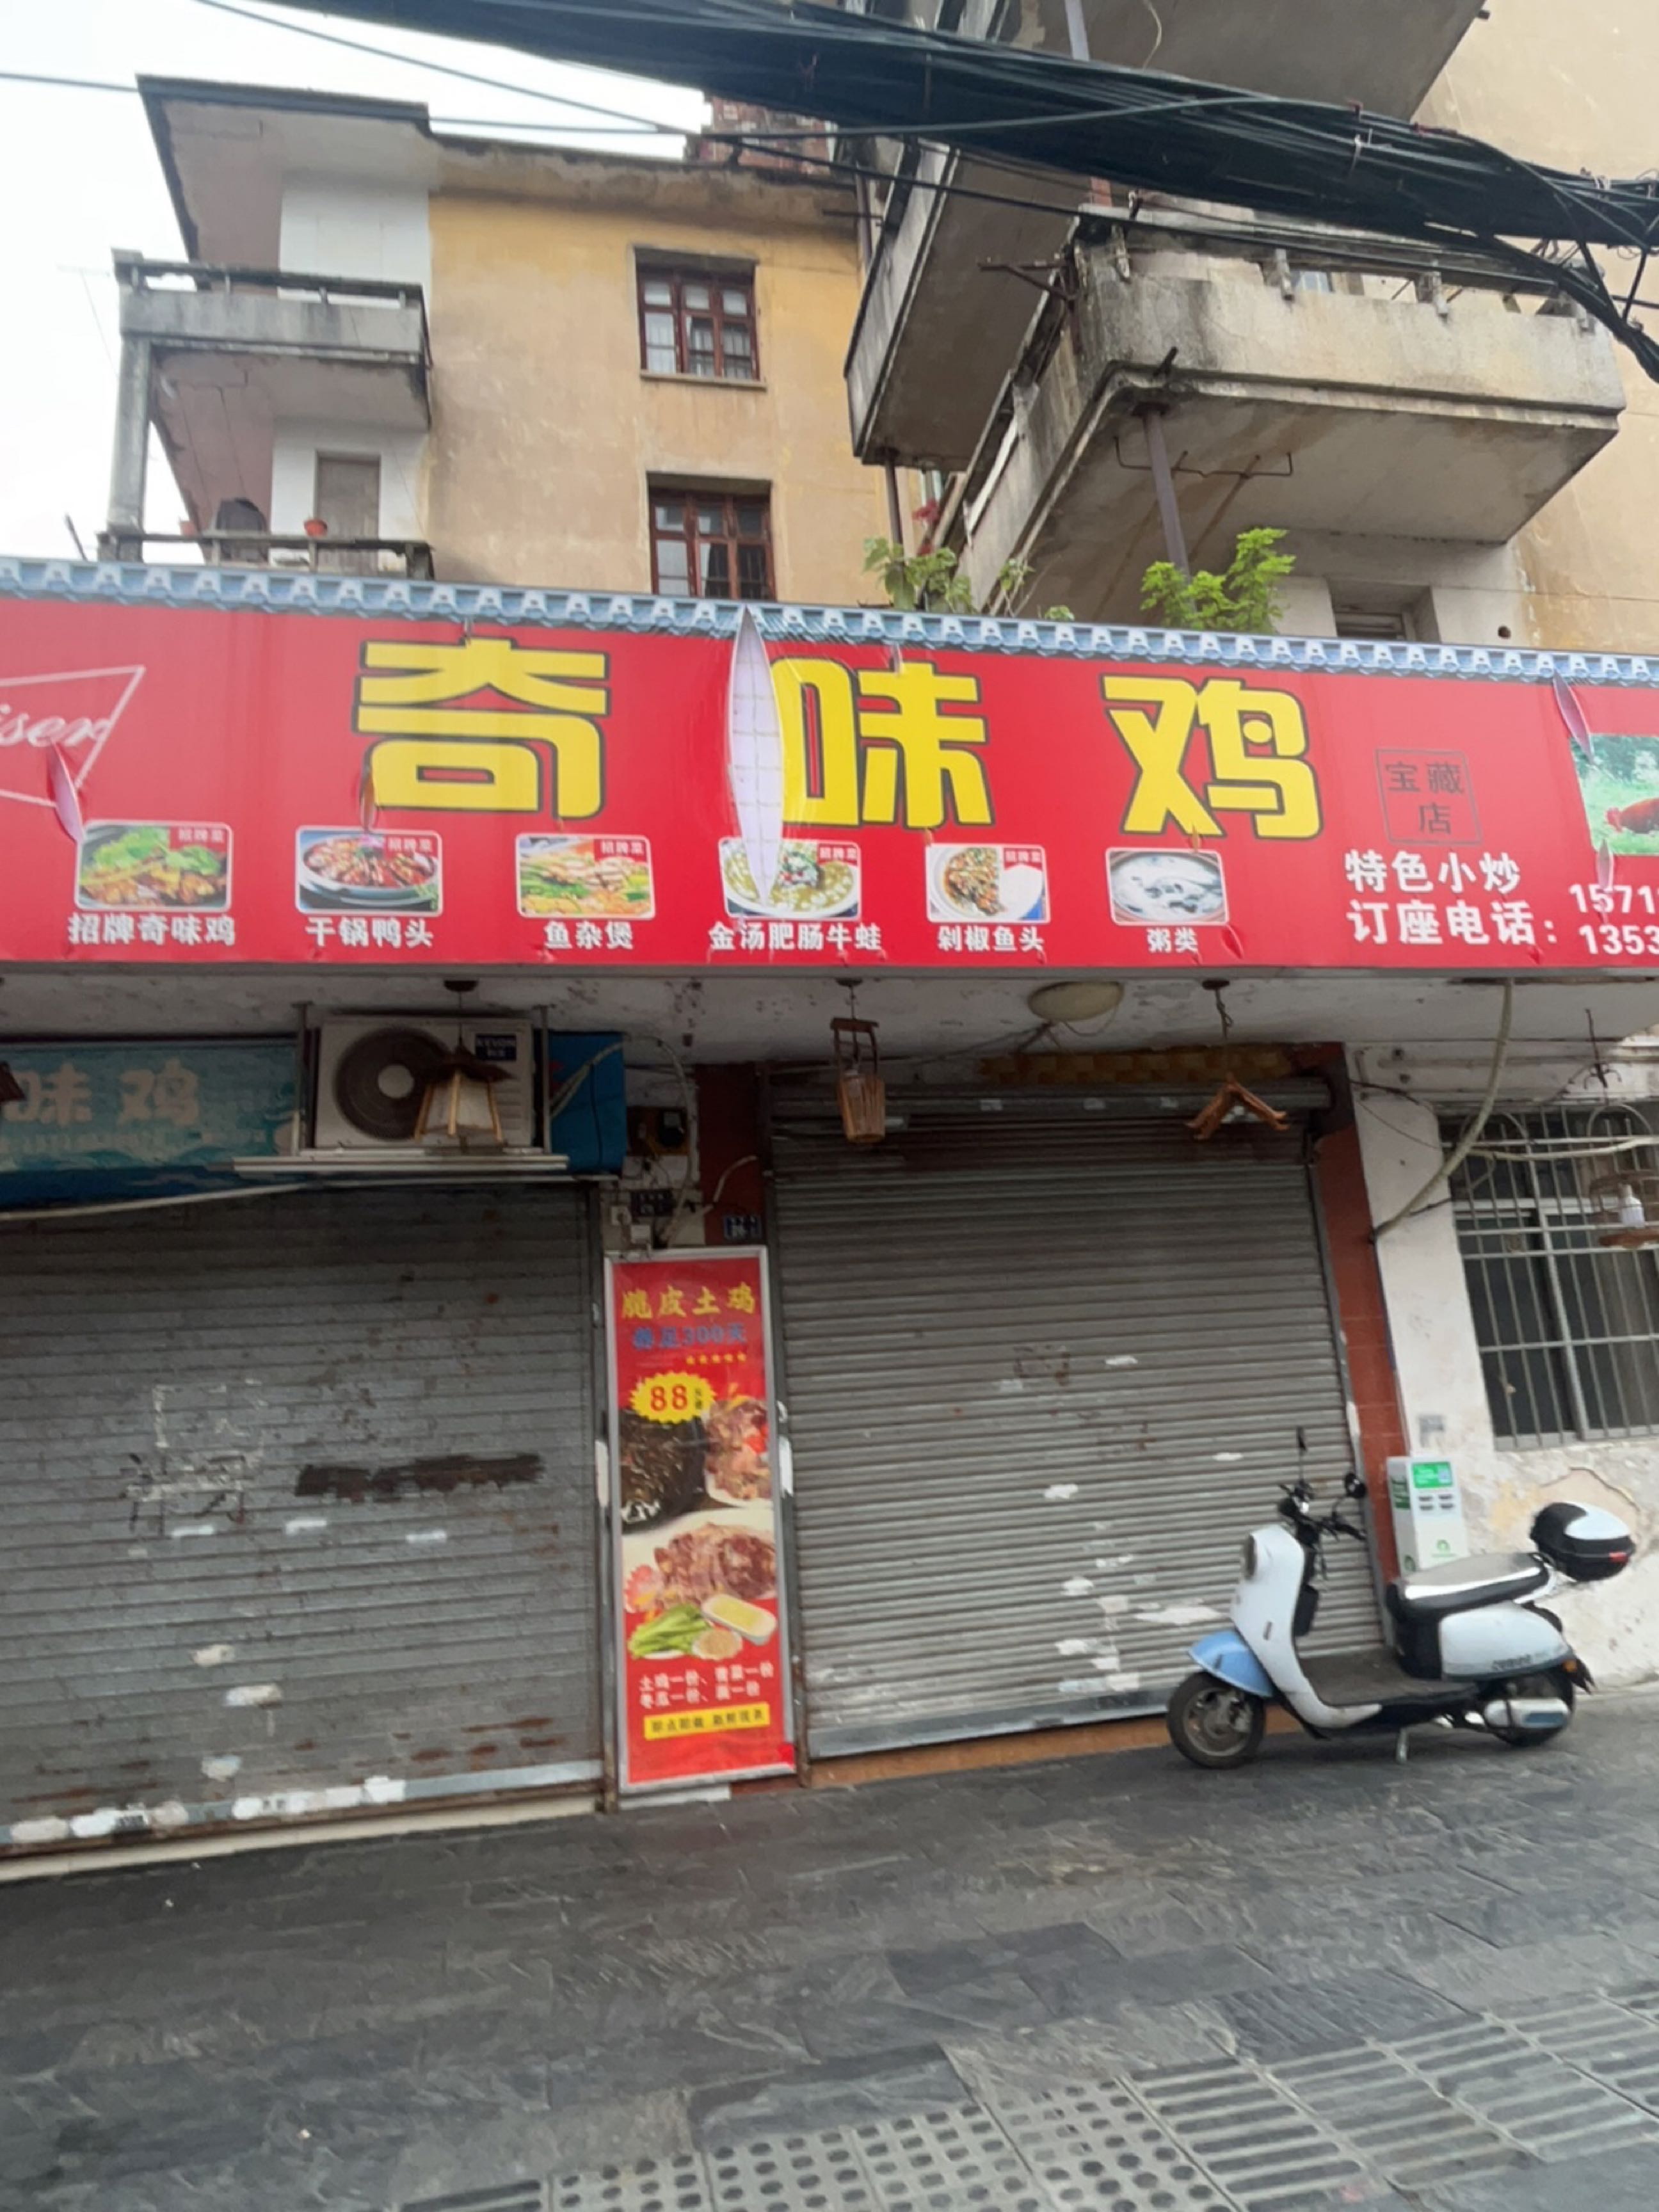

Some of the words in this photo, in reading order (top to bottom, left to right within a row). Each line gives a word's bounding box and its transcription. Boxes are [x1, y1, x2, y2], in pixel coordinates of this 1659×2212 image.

[351, 636, 1323, 839] 奇味鸡
[1385, 761, 1464, 794] 宝藏
[1418, 803, 1452, 834] 店
[1345, 849, 1520, 894] 特色小炒
[1569, 883, 1659, 914] 1571
[68, 912, 235, 946] 招牌奇味鸡
[305, 917, 434, 947] 干锅鸭头
[544, 921, 634, 950] 鱼杂煲
[708, 922, 882, 952] 金汤肥肠牛蛙
[937, 926, 1045, 952] 剁椒鱼头
[1147, 927, 1198, 953] 粥类
[650, 1383, 688, 1412] 88
